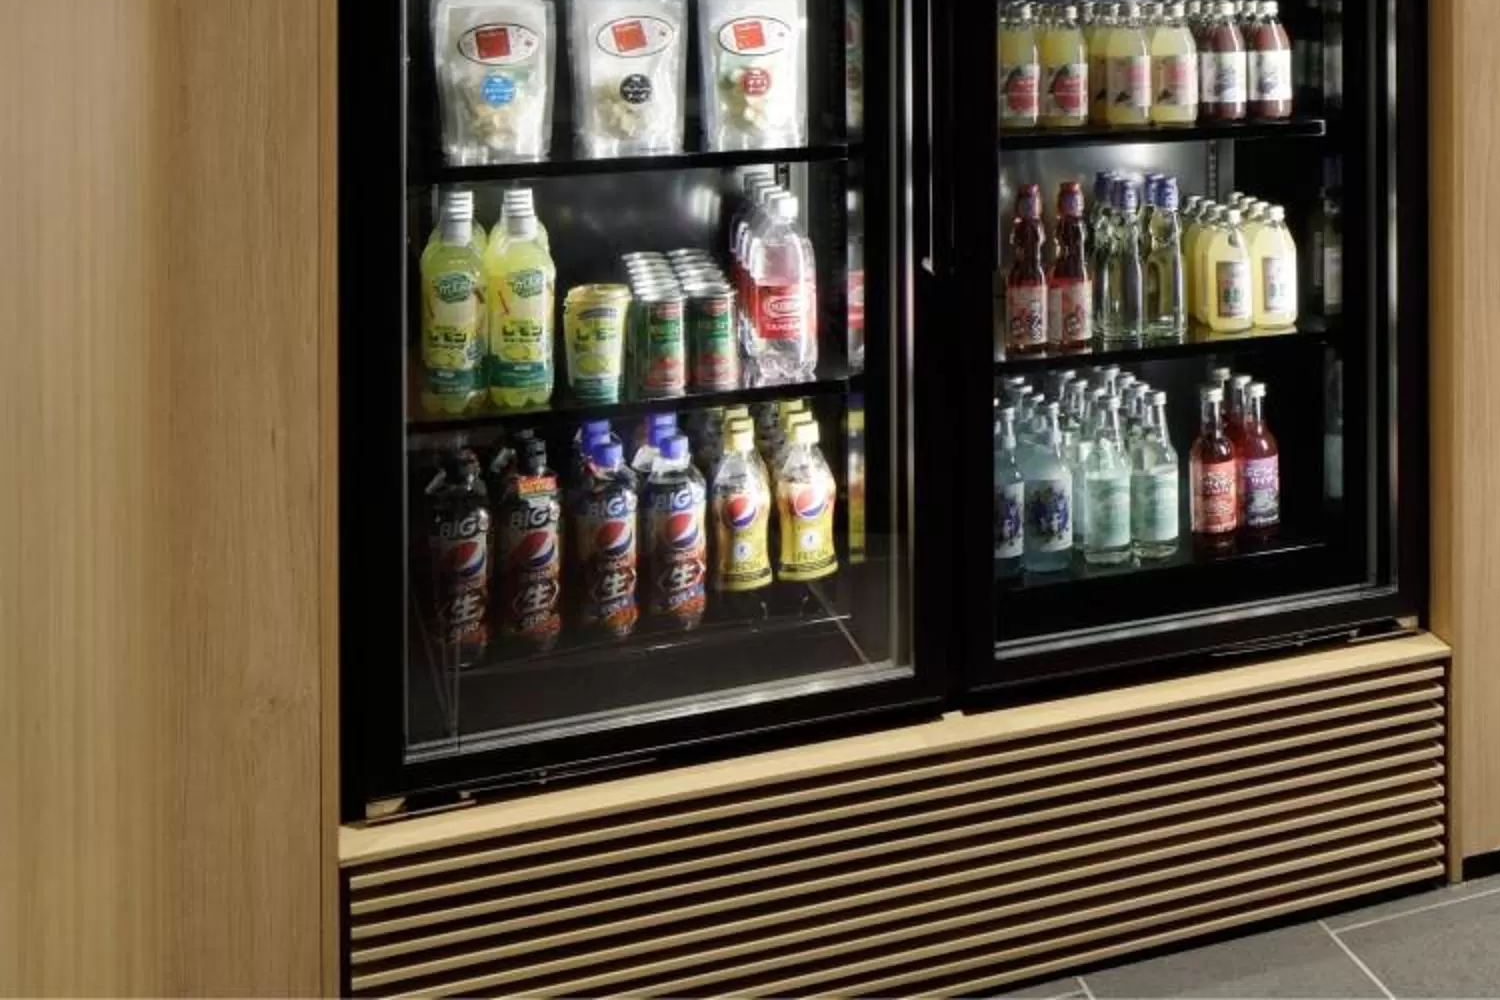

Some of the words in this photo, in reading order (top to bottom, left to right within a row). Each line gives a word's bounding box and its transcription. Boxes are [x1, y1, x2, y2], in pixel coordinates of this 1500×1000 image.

[440, 516, 477, 538] BIG
[511, 506, 549, 530] BIG
[601, 573, 628, 601] 生
[669, 563, 696, 592] 生
[451, 594, 481, 623] 生
[522, 583, 551, 614] 生
